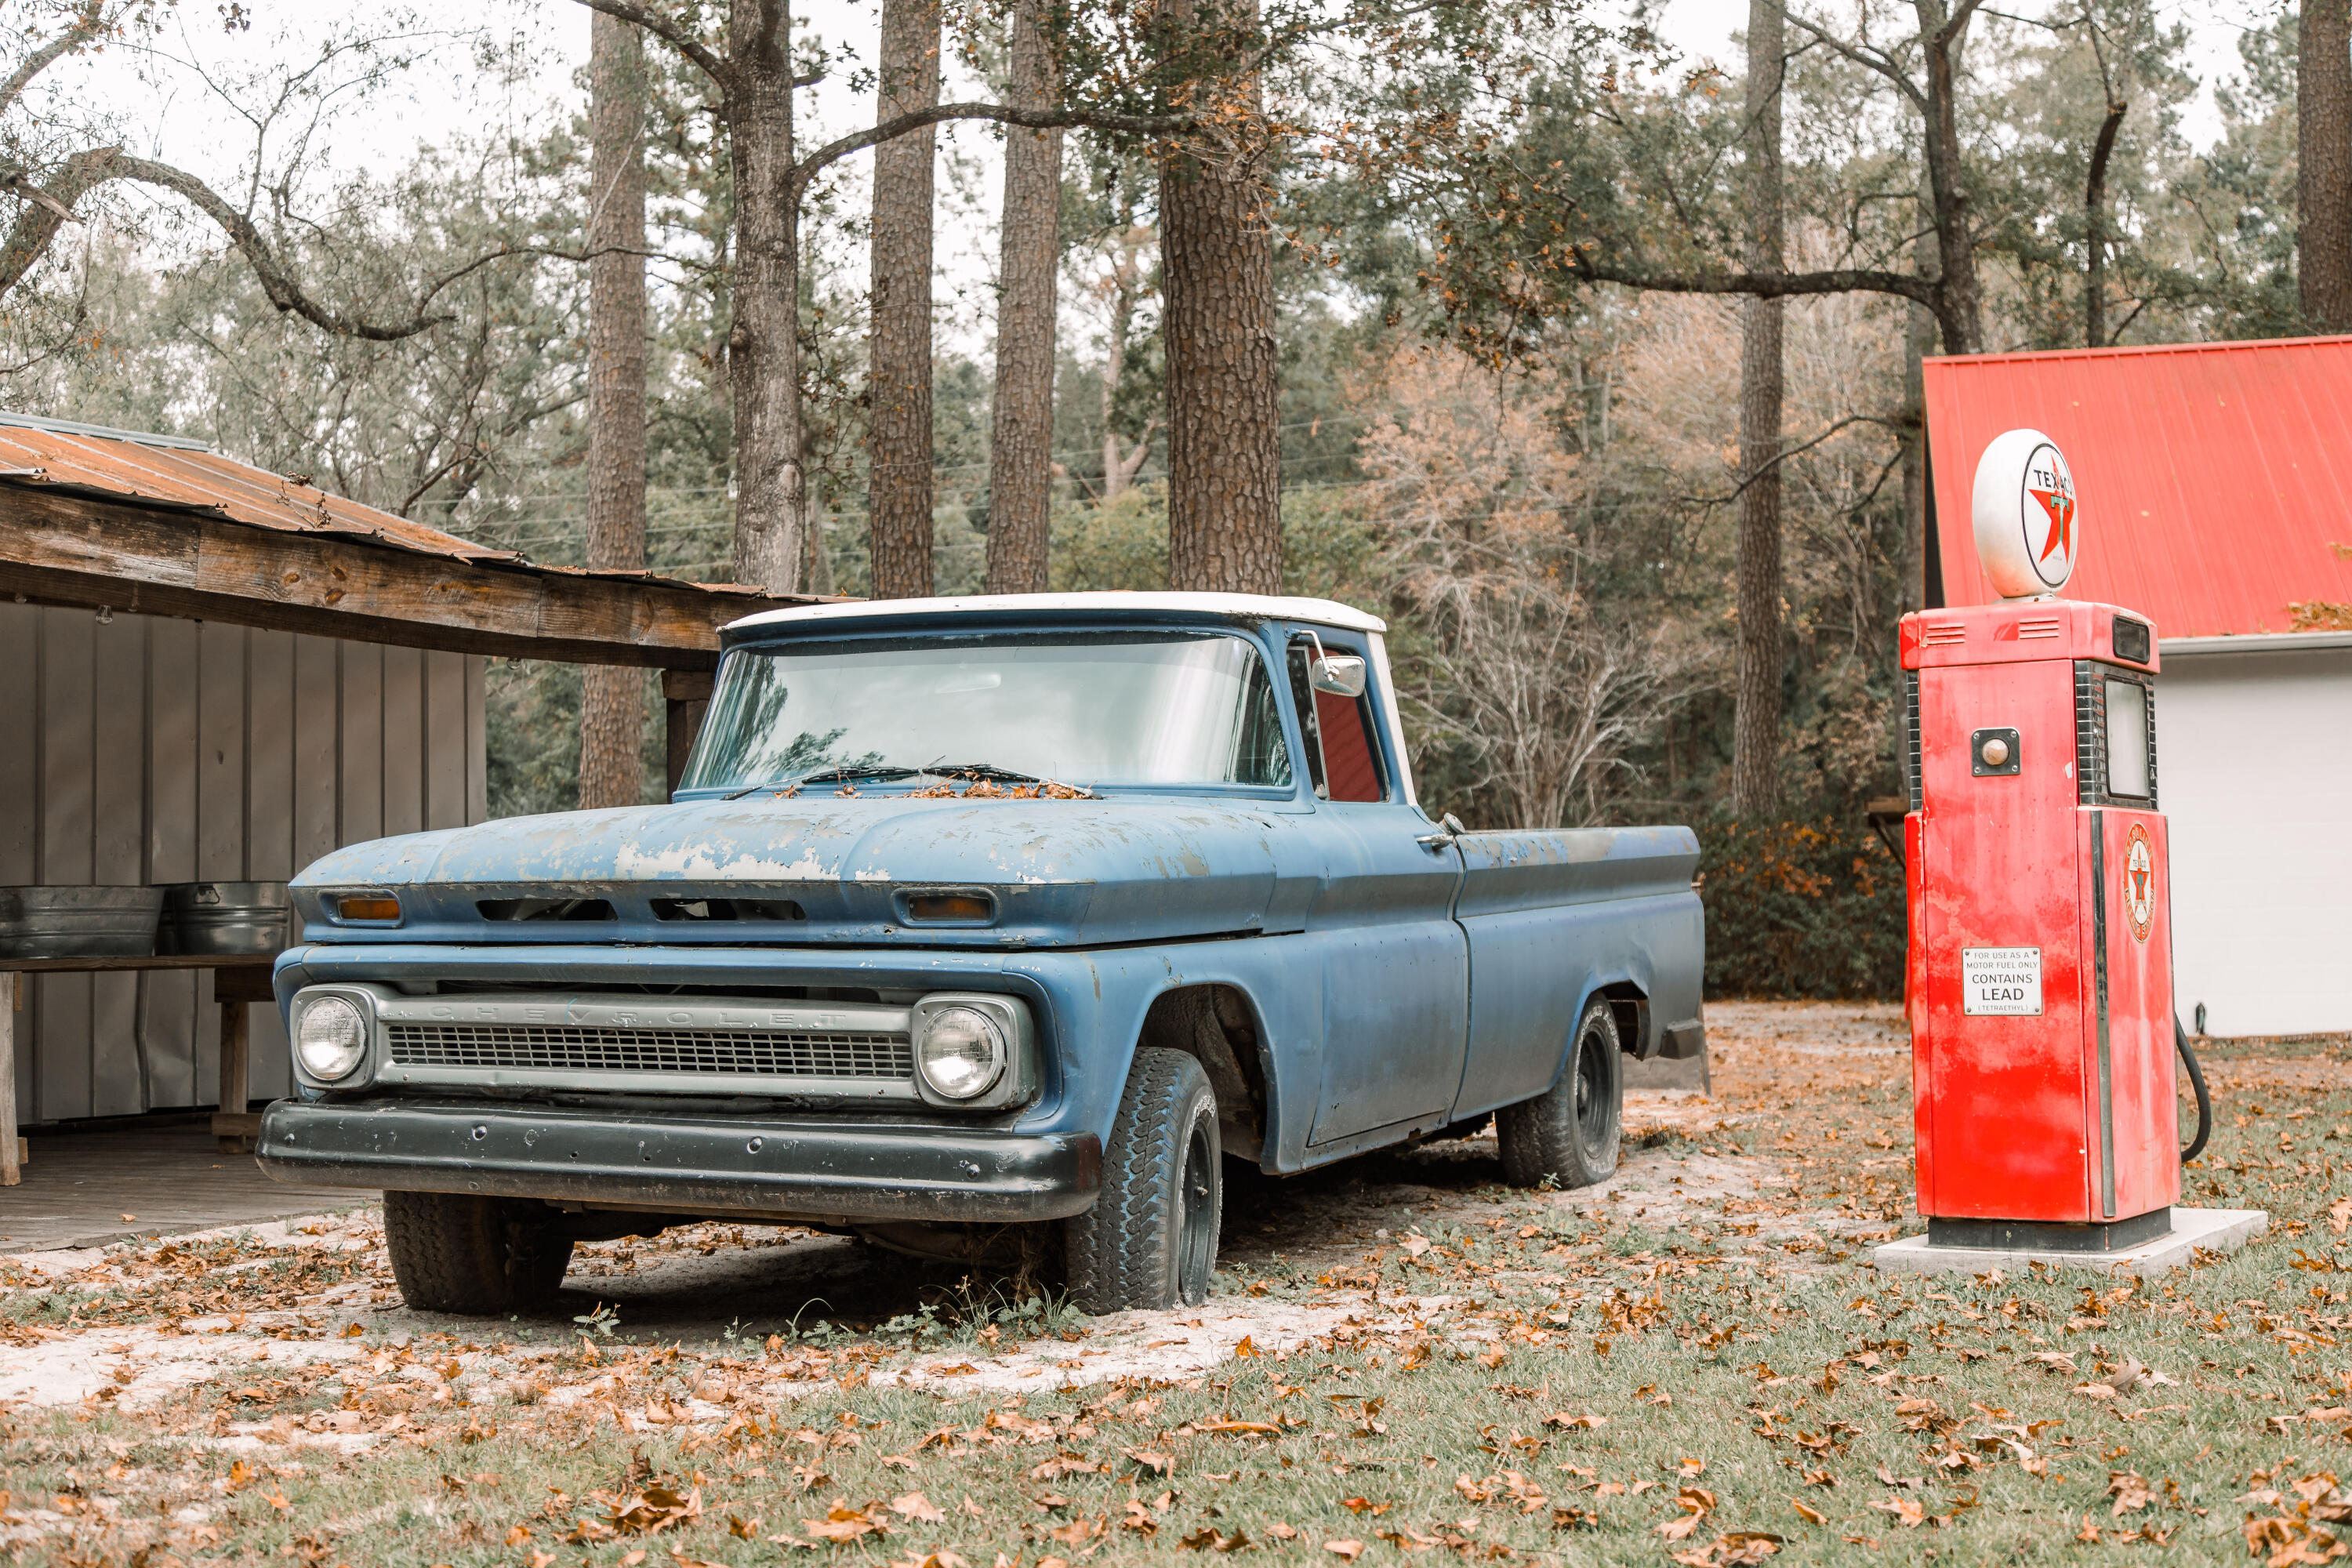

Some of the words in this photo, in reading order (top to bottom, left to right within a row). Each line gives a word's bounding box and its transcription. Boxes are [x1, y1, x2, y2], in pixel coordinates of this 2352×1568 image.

[1972, 974, 2033, 984] CONTAINS
[1982, 988, 2024, 1000] LEAD
[430, 1005, 847, 1026] CHEVROLET
